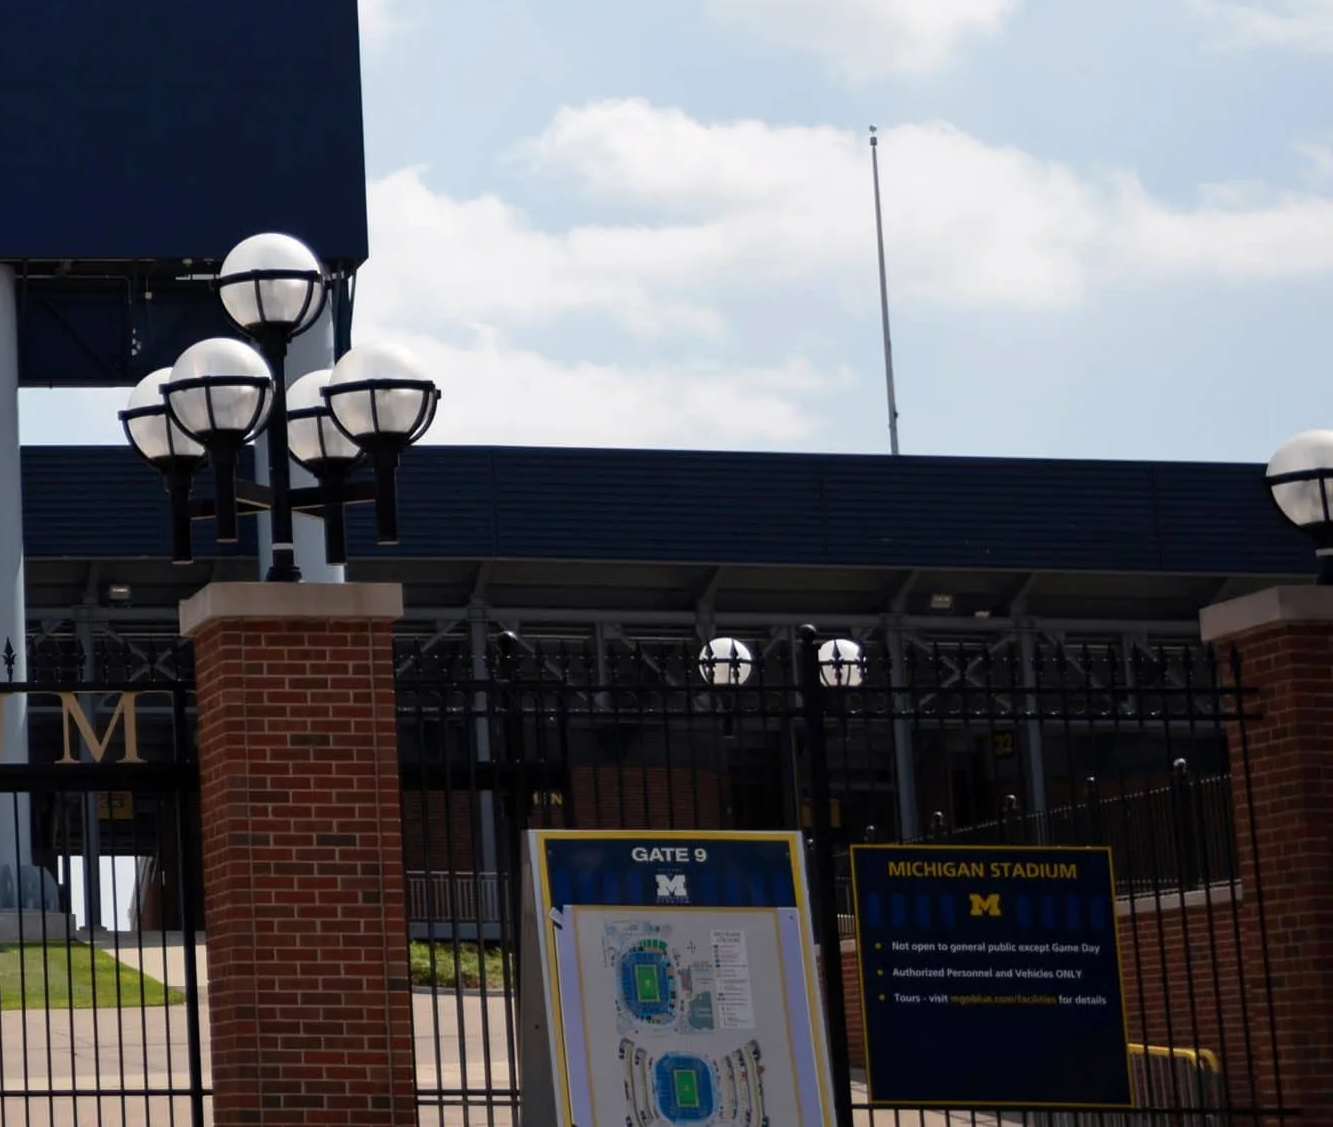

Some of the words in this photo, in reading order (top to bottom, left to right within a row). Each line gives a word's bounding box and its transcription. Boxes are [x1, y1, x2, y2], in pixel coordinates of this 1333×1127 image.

[632, 847, 690, 862] GATE
[694, 848, 707, 862] 9
[888, 862, 984, 878] MICHIGAN
[990, 862, 1077, 879] STADIUM
[655, 874, 688, 897] M
[969, 893, 1002, 916] M
[892, 941, 910, 951] Not
[911, 943, 936, 953] open
[937, 942, 948, 951] to
[950, 942, 986, 953] general
[988, 942, 1017, 953] public
[1018, 942, 1050, 954] except
[1051, 942, 1079, 953] Game
[1081, 943, 1101, 955] Day
[893, 967, 945, 977] Authorized
[946, 967, 992, 977] Personnel
[995, 968, 1013, 978] and
[1015, 968, 1053, 978] Vehicles
[1055, 969, 1082, 979] ONLY
[894, 993, 921, 1003] Tours
[928, 993, 948, 1003] visit
[1058, 994, 1073, 1004] for
[1075, 995, 1107, 1005] details
